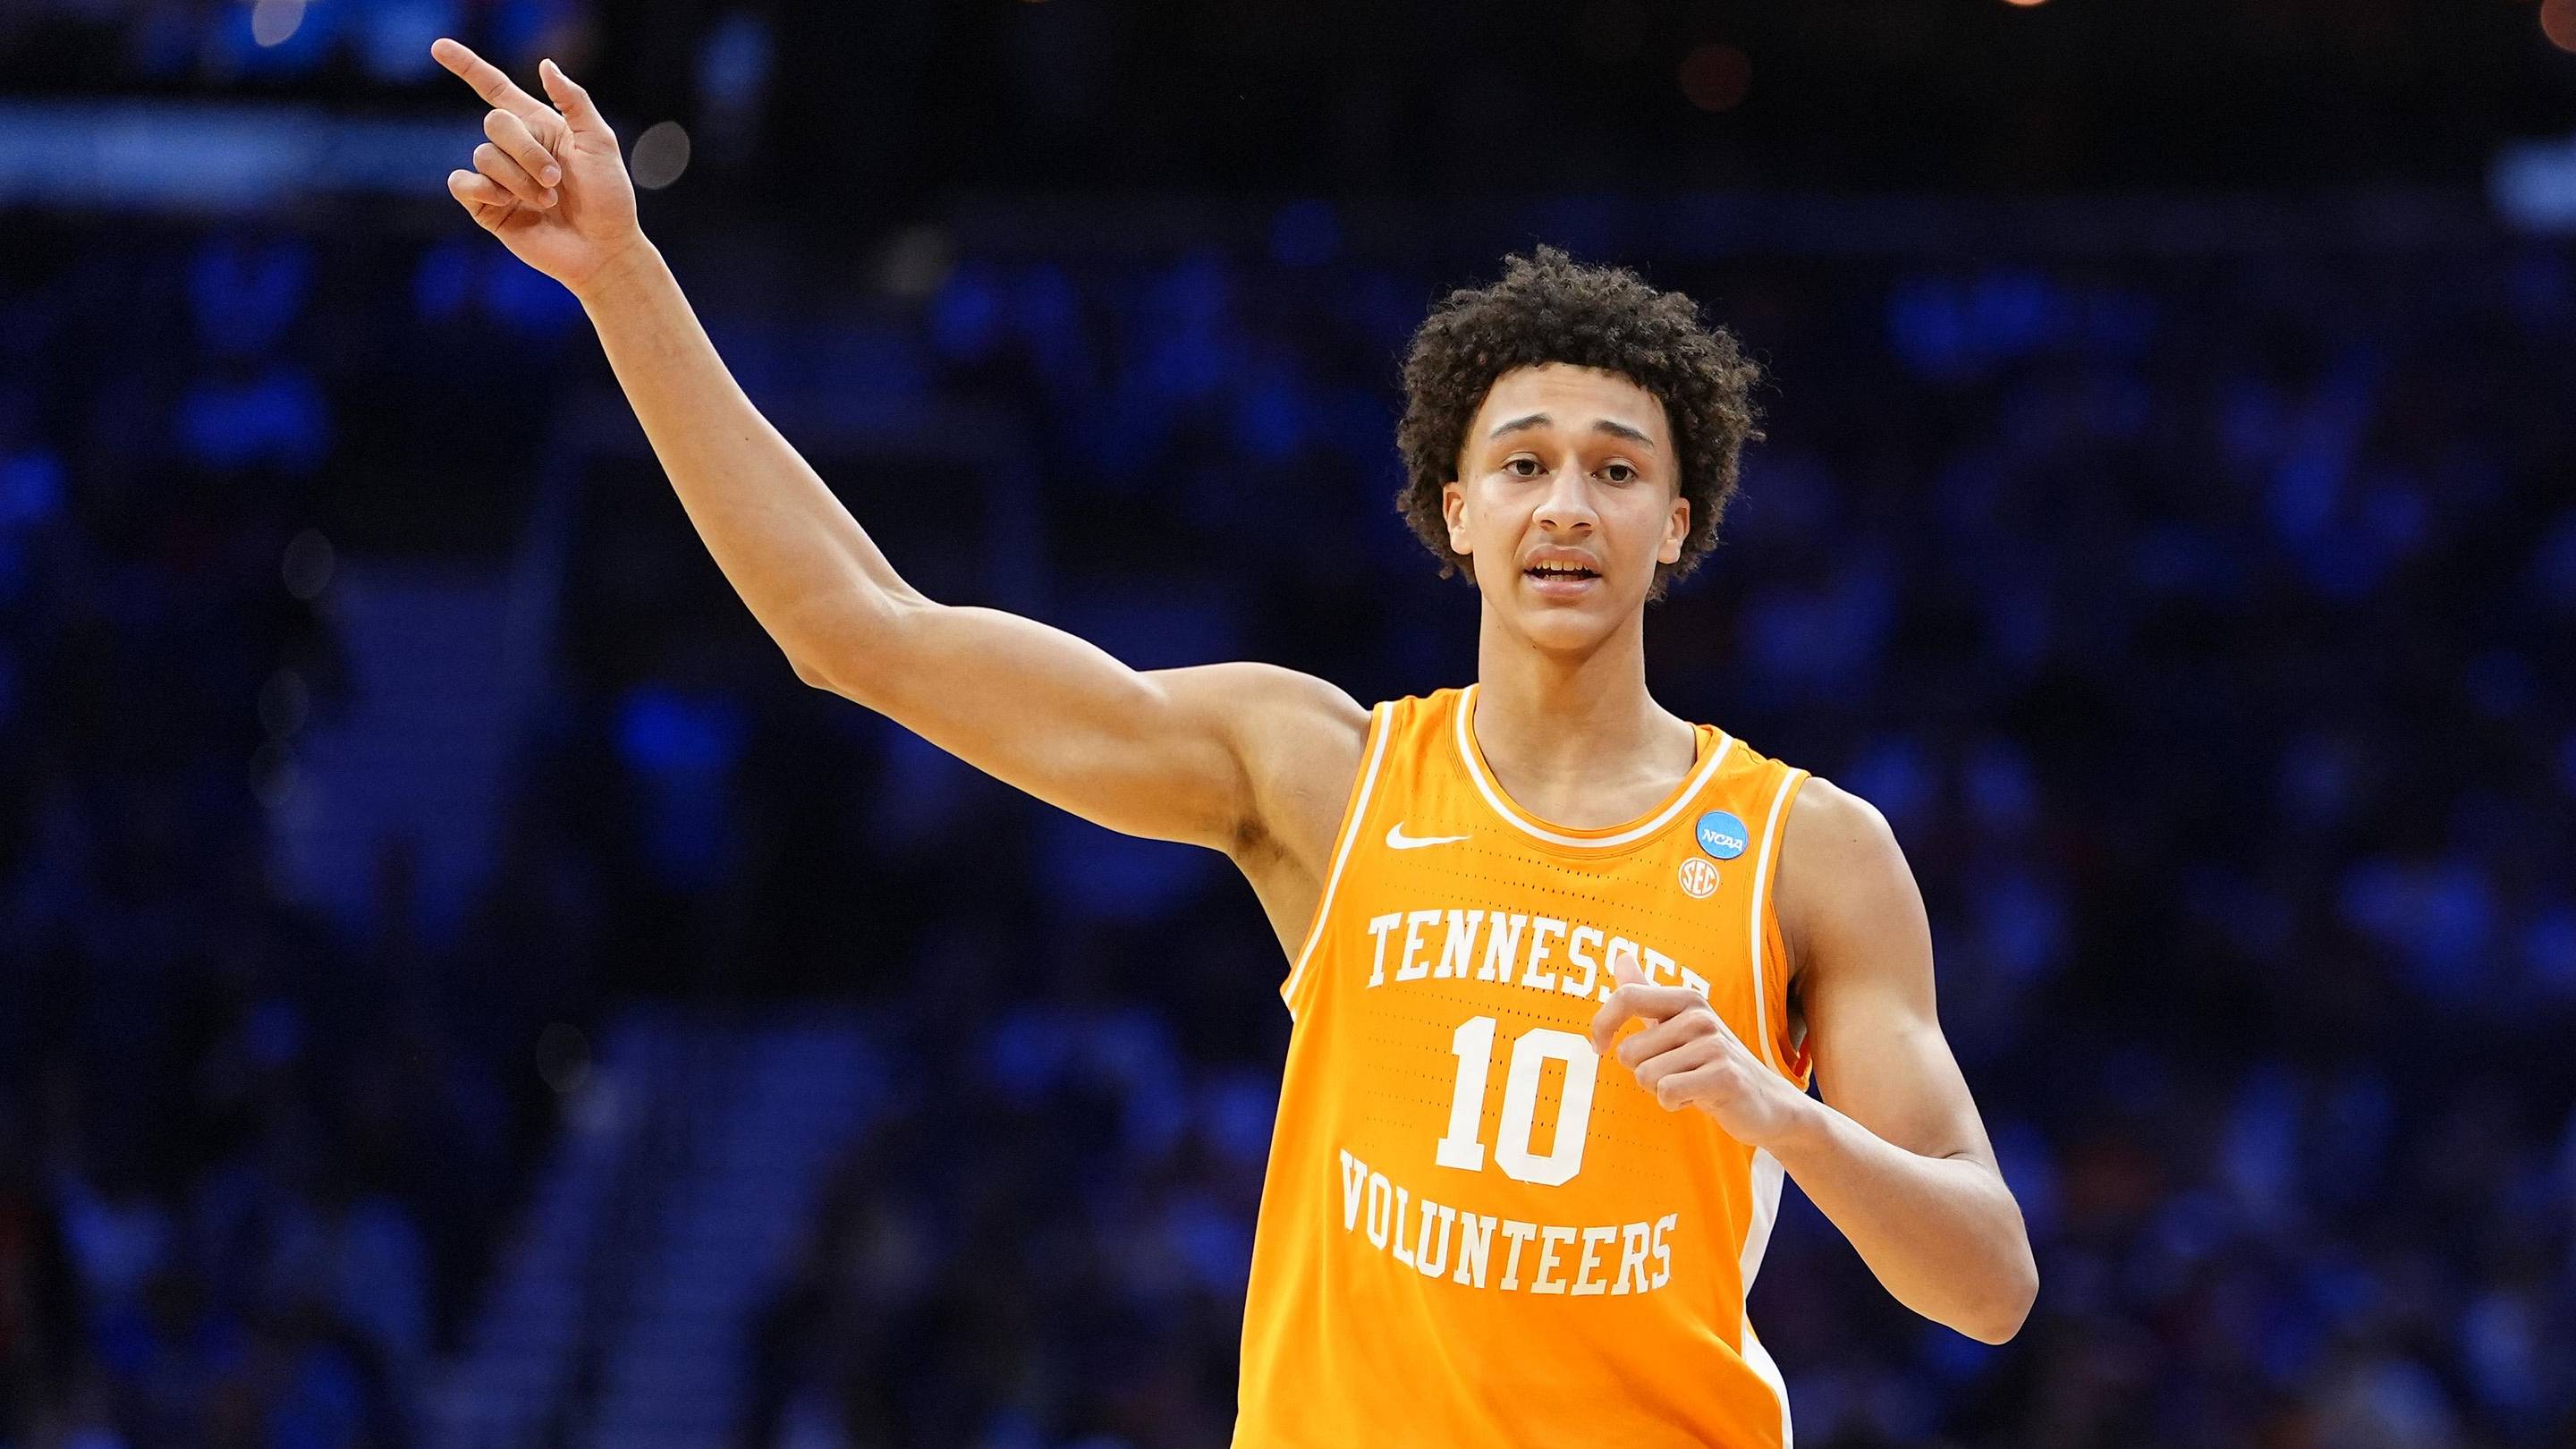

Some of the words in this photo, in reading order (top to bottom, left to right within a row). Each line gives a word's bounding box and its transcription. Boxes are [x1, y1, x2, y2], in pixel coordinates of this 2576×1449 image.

[1682, 859, 1716, 895] SEC
[1702, 828, 1744, 852] NCAA
[1435, 1015, 1600, 1187] 10
[1340, 1148, 1679, 1296] VOLUNTEERS
